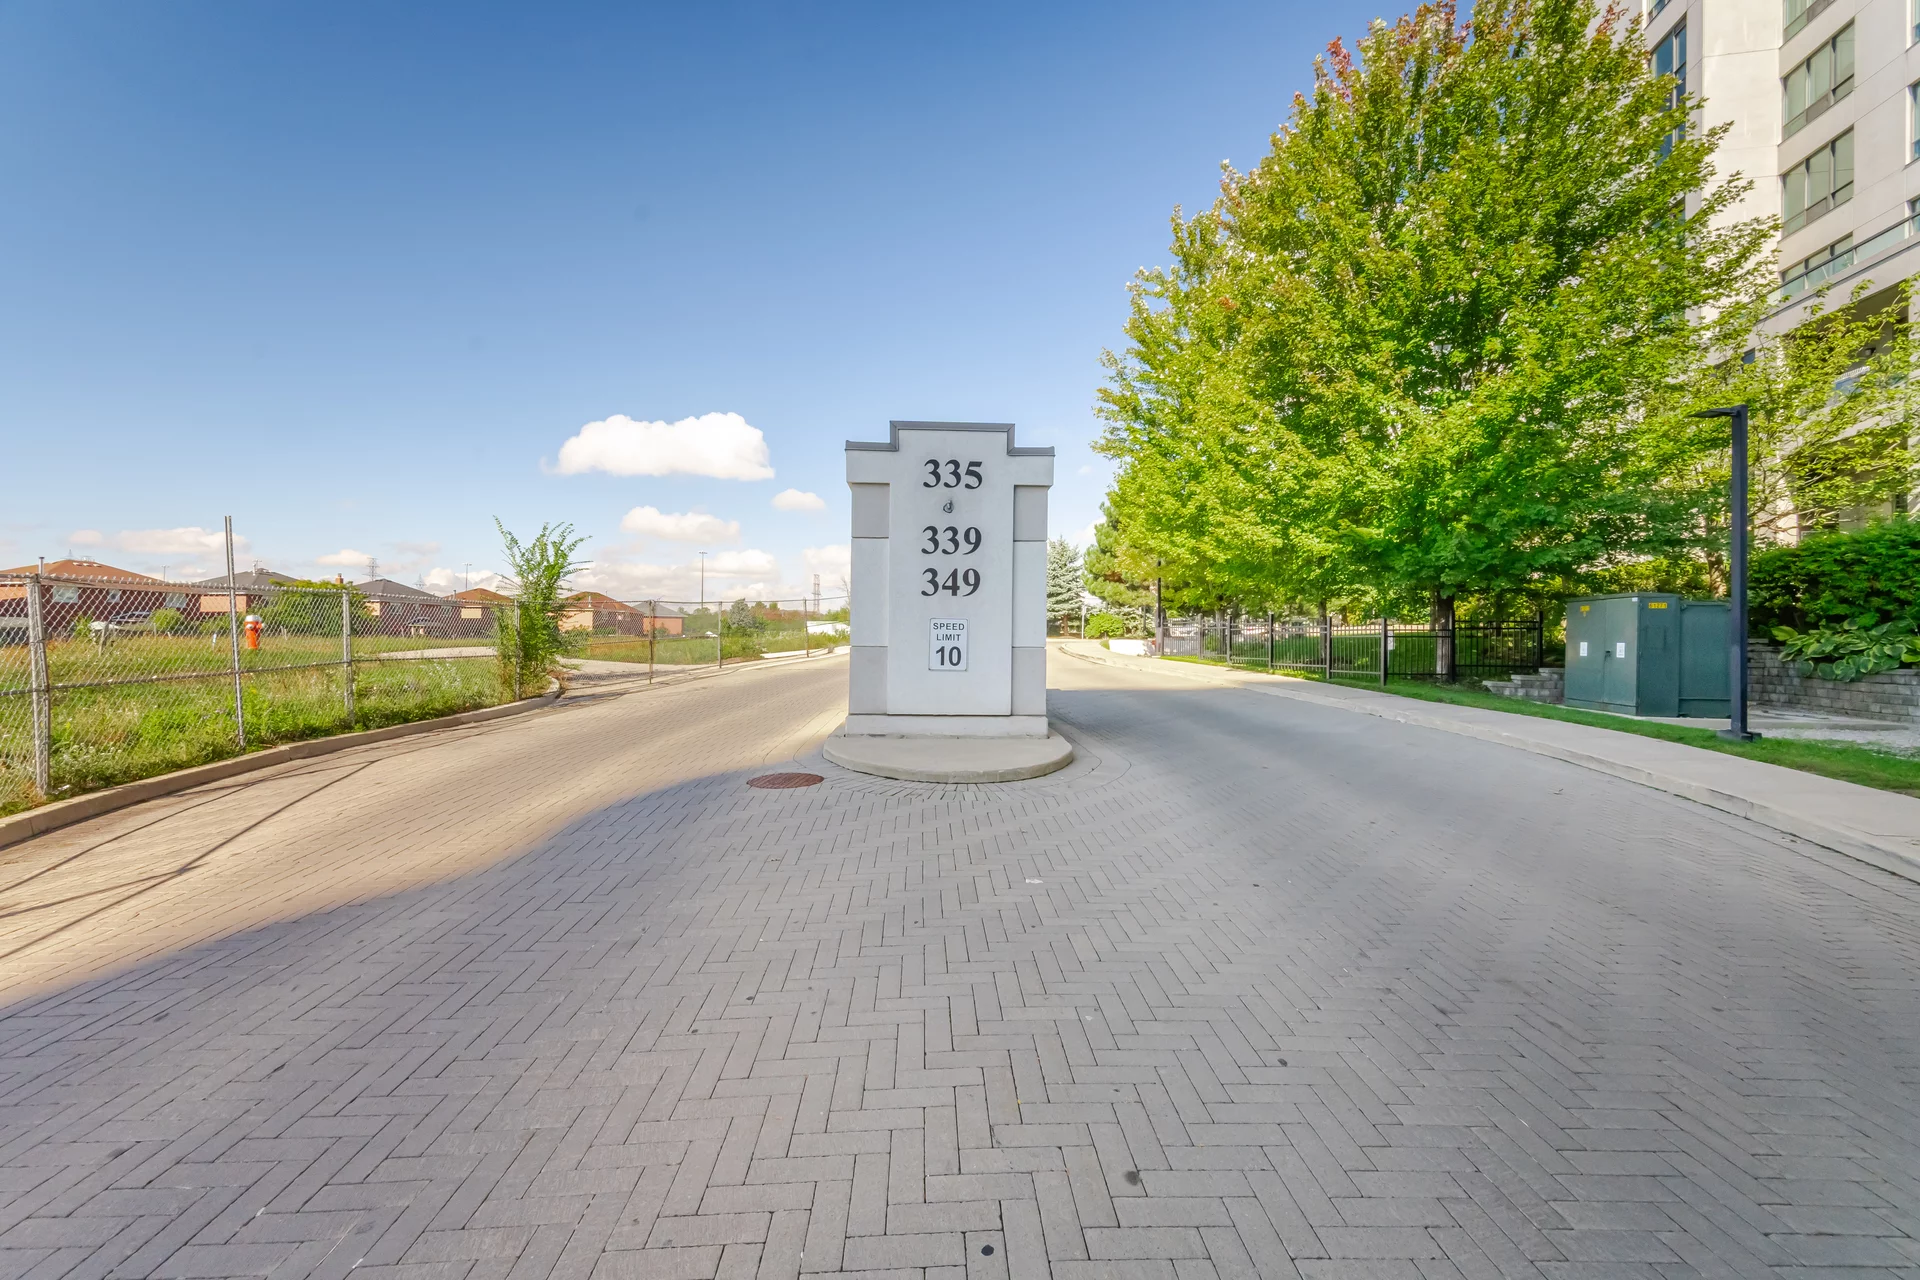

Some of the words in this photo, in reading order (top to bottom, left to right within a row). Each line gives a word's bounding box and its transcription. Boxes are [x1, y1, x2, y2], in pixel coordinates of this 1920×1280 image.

[922, 458, 983, 490] 335
[920, 525, 982, 556] 339
[920, 567, 981, 598] 349
[932, 622, 965, 631] SPEED
[936, 633, 962, 642] LIMIT
[935, 645, 962, 667] 10
